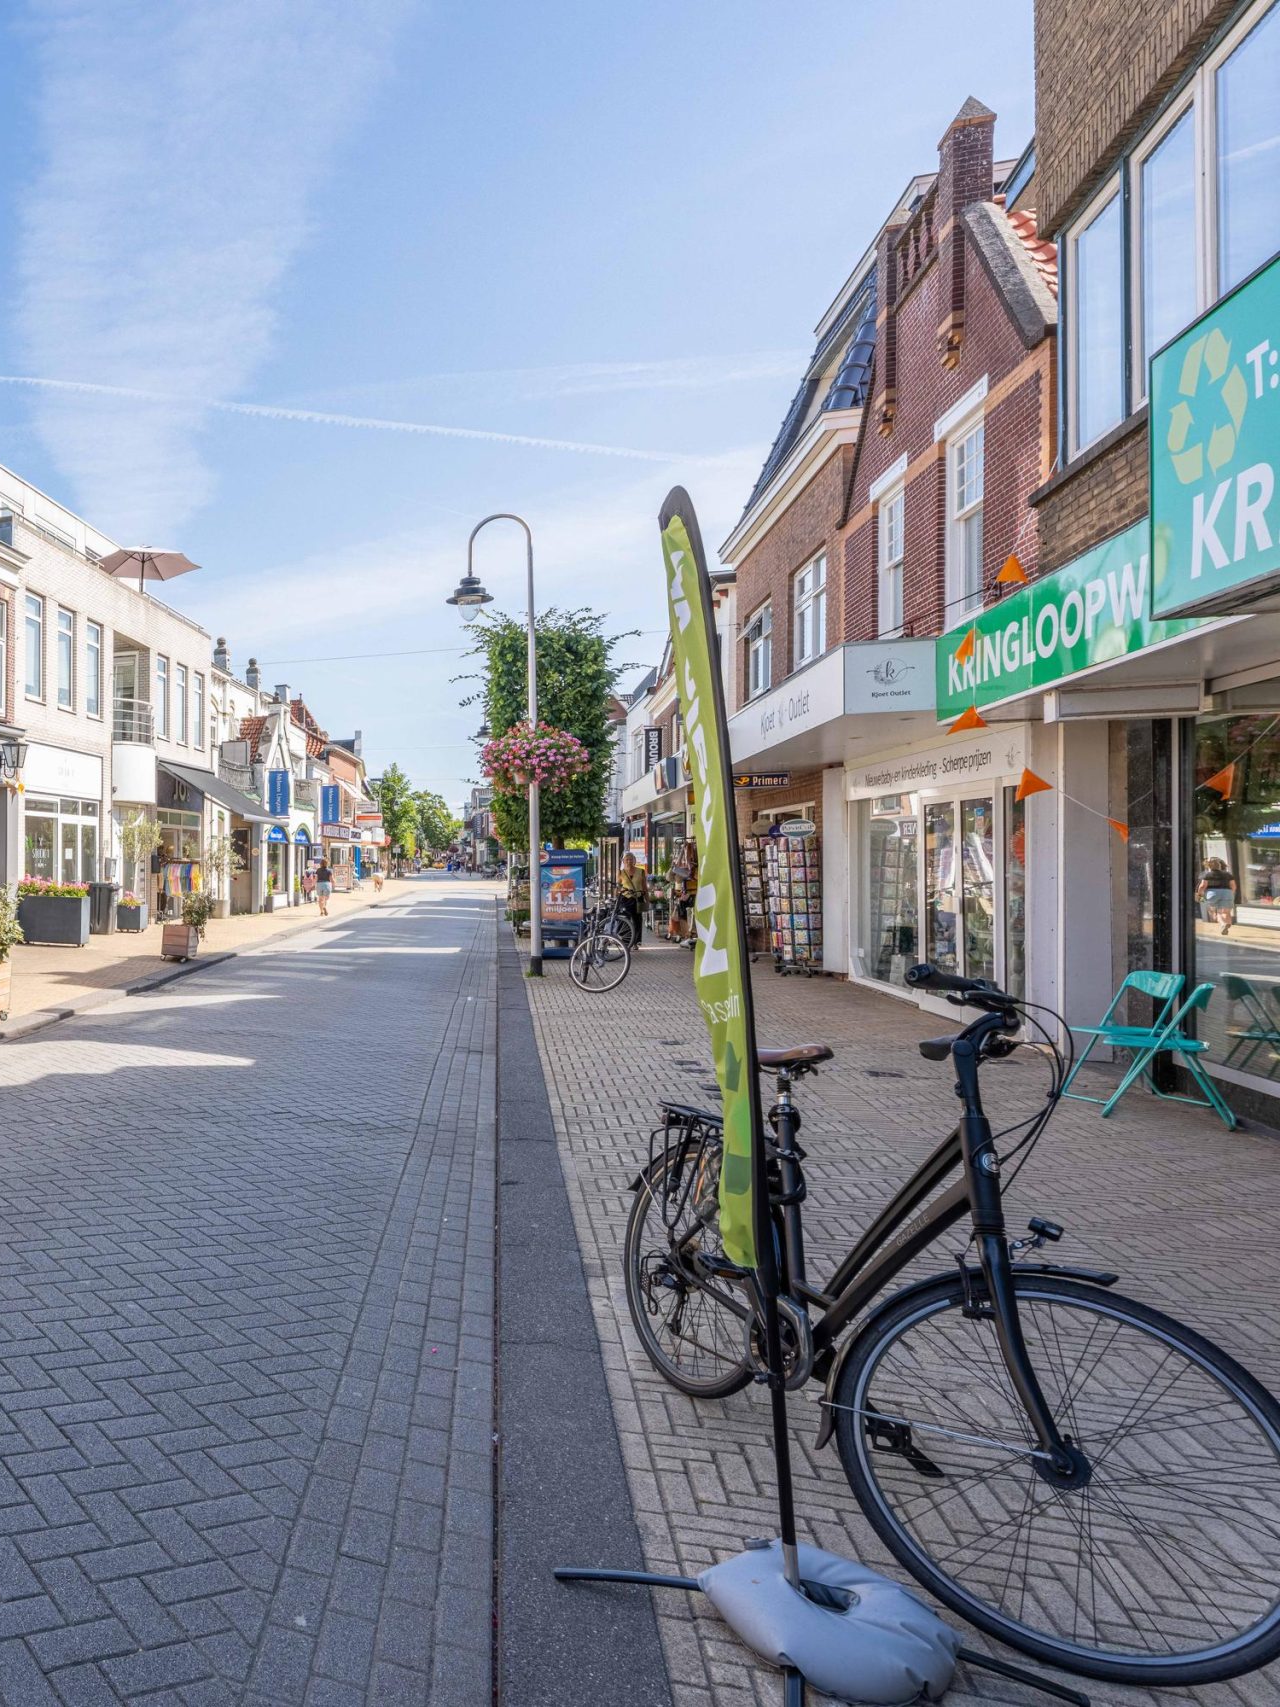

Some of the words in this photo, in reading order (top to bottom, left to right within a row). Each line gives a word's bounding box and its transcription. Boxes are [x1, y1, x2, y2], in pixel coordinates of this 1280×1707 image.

[1191, 462, 1280, 580] KR
[871, 690, 889, 699] Kjoet
[889, 689, 911, 697] Outlet
[760, 709, 775, 739] Kjoet
[788, 689, 810, 722] Outlet
[942, 753, 968, 775] Scherpe
[968, 749, 992, 772] prijzen
[752, 776, 788, 786] Primera
[545, 892, 578, 906] 11,1
[545, 905, 578, 914] miljoen
[896, 1213, 930, 1247] GAZELLE
